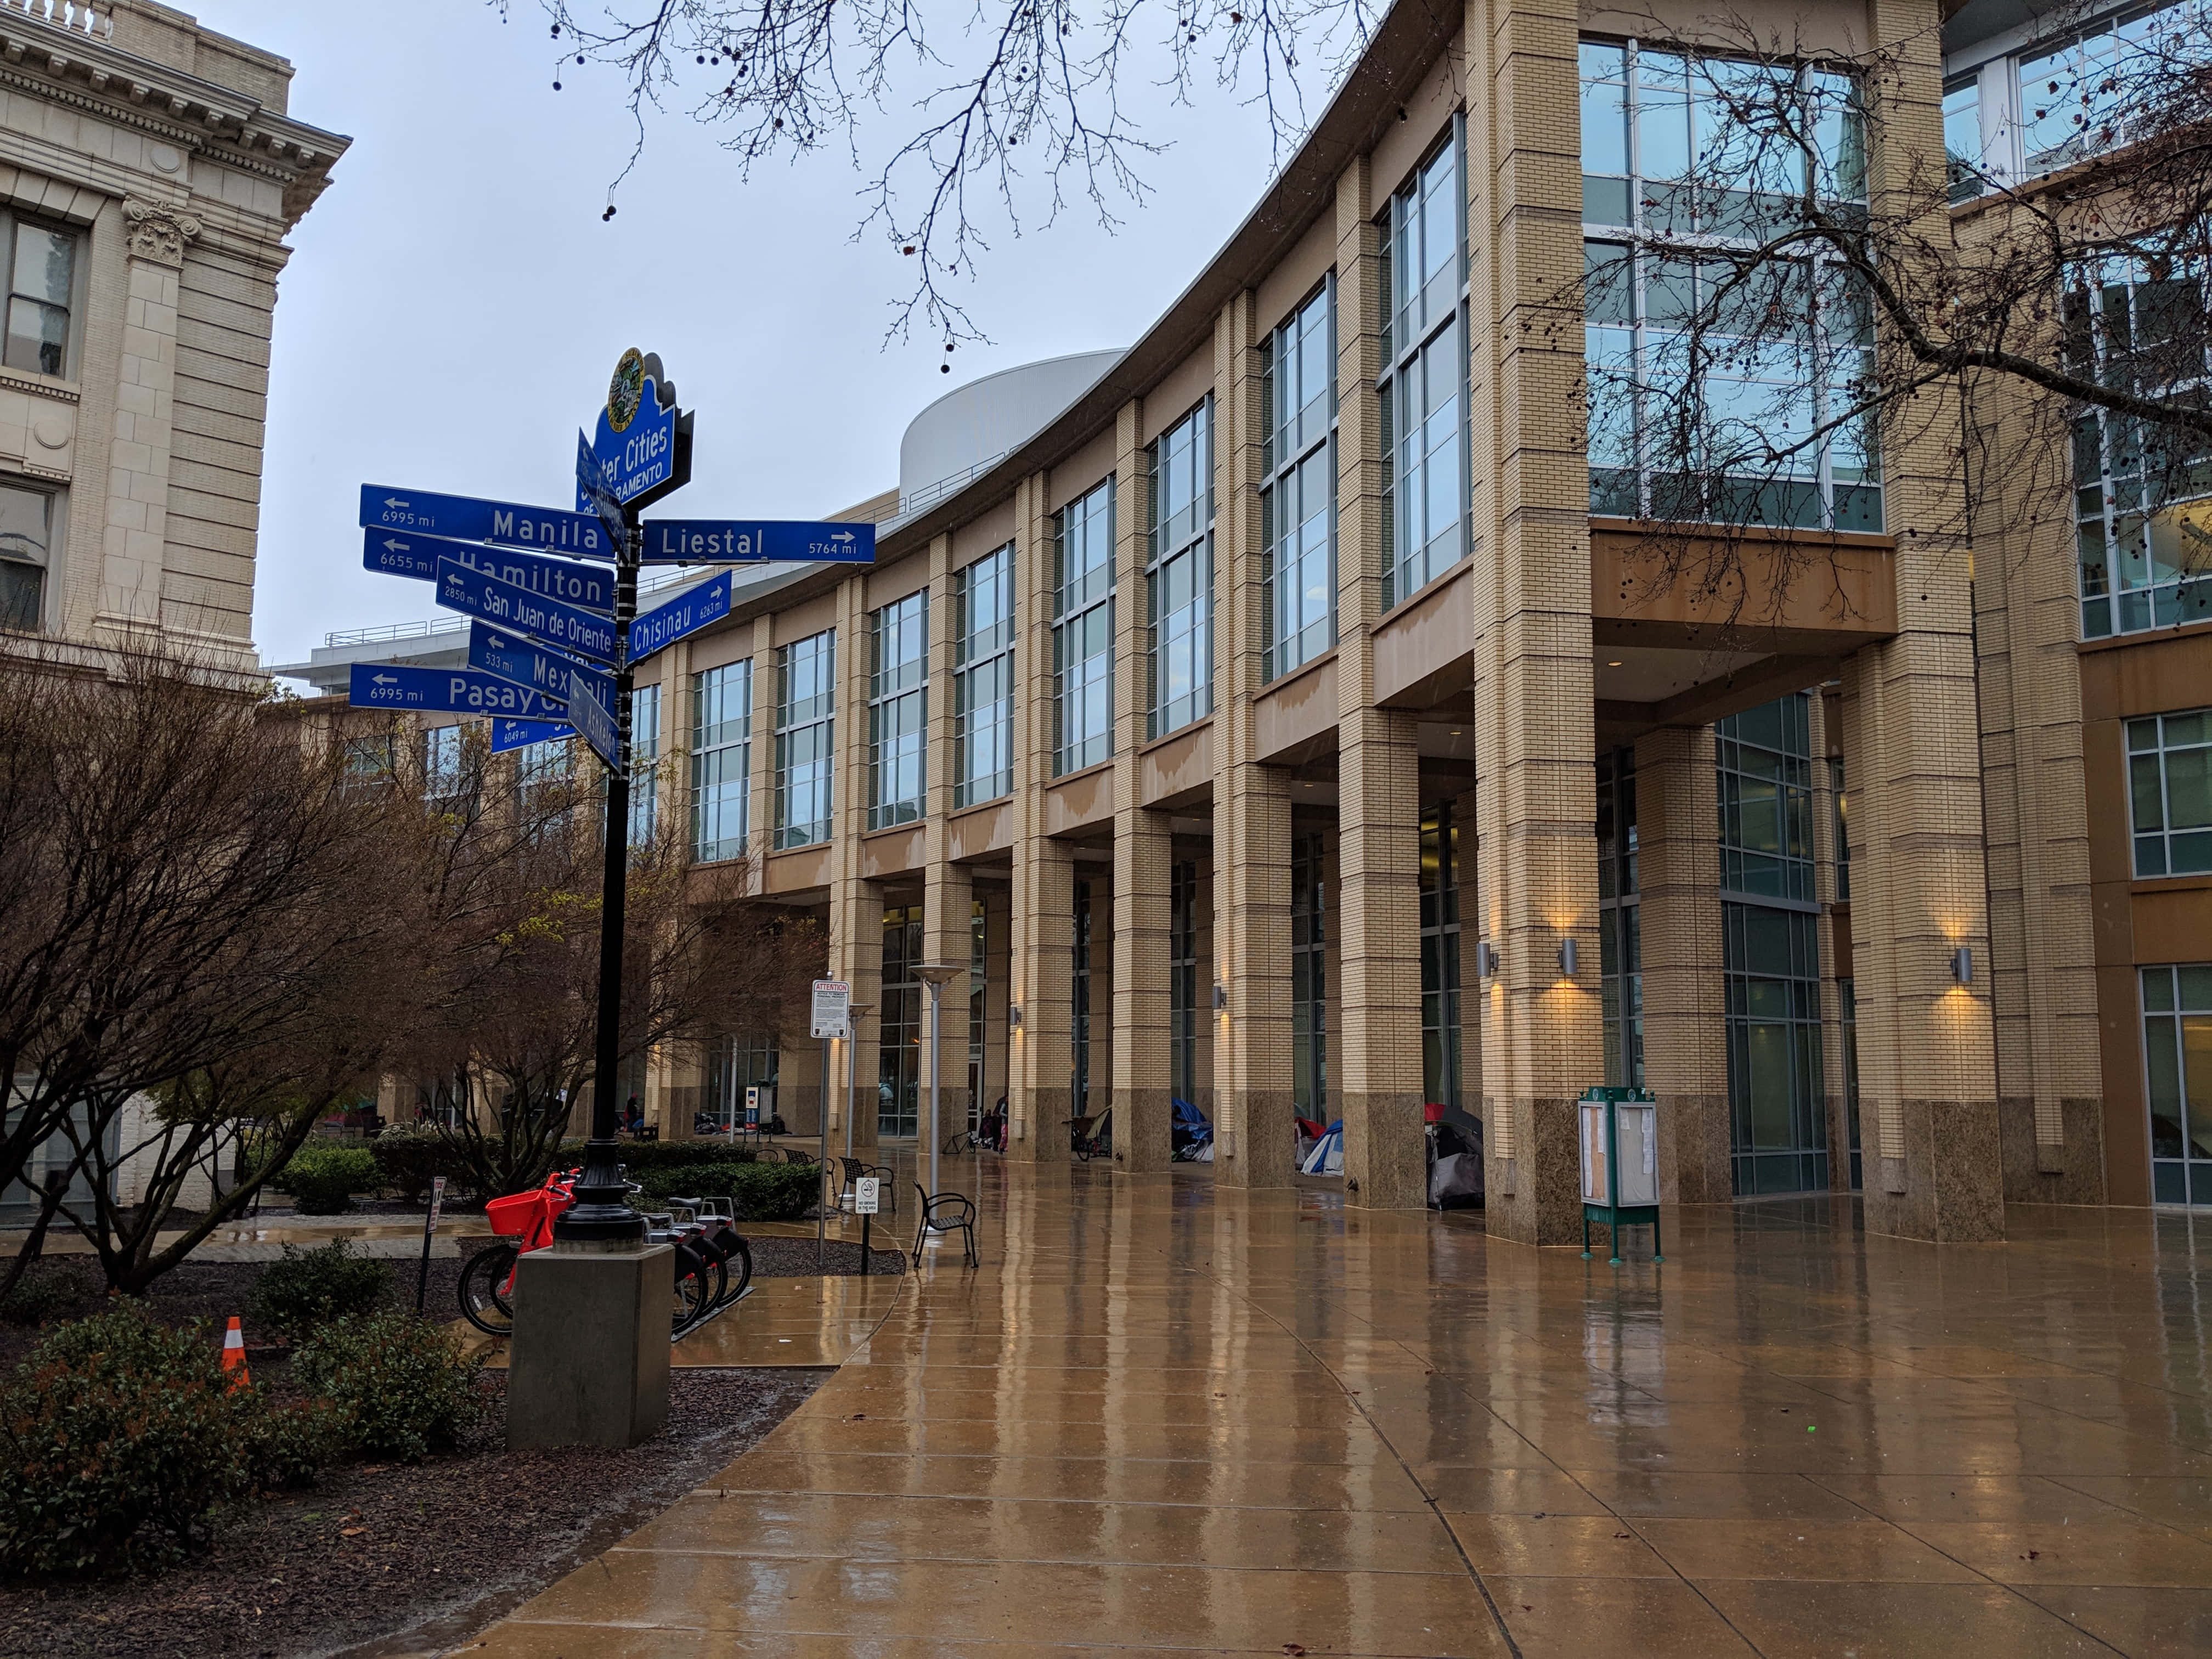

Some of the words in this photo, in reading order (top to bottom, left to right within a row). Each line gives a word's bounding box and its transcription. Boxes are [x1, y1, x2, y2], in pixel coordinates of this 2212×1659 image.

[626, 426, 667, 471] Cities
[616, 462, 663, 500] RAMENTO
[382, 511, 415, 524] 6995
[419, 516, 435, 527] mi
[494, 510, 597, 549] Manila
[662, 528, 762, 554] Liestal
[809, 543, 838, 554] 5764
[842, 544, 856, 554] mi
[381, 553, 413, 568] 6655
[417, 561, 433, 573] mi
[445, 586, 465, 601] 2850
[467, 596, 477, 606] mi
[484, 586, 509, 618] San
[514, 599, 545, 630] Juan
[549, 612, 564, 636] de
[568, 617, 611, 652] Oriente
[699, 603, 714, 619] 6263
[715, 600, 723, 611] mi
[634, 606, 691, 652] Chisinau
[486, 652, 500, 668] 533
[503, 661, 513, 673] mi
[534, 654, 606, 708] Mexali
[370, 687, 403, 700] 6995
[407, 691, 423, 702] mi
[450, 678, 534, 713] Pasay
[504, 731, 519, 743] 6049
[520, 729, 528, 738] mi
[586, 704, 616, 757] Ashkelon
